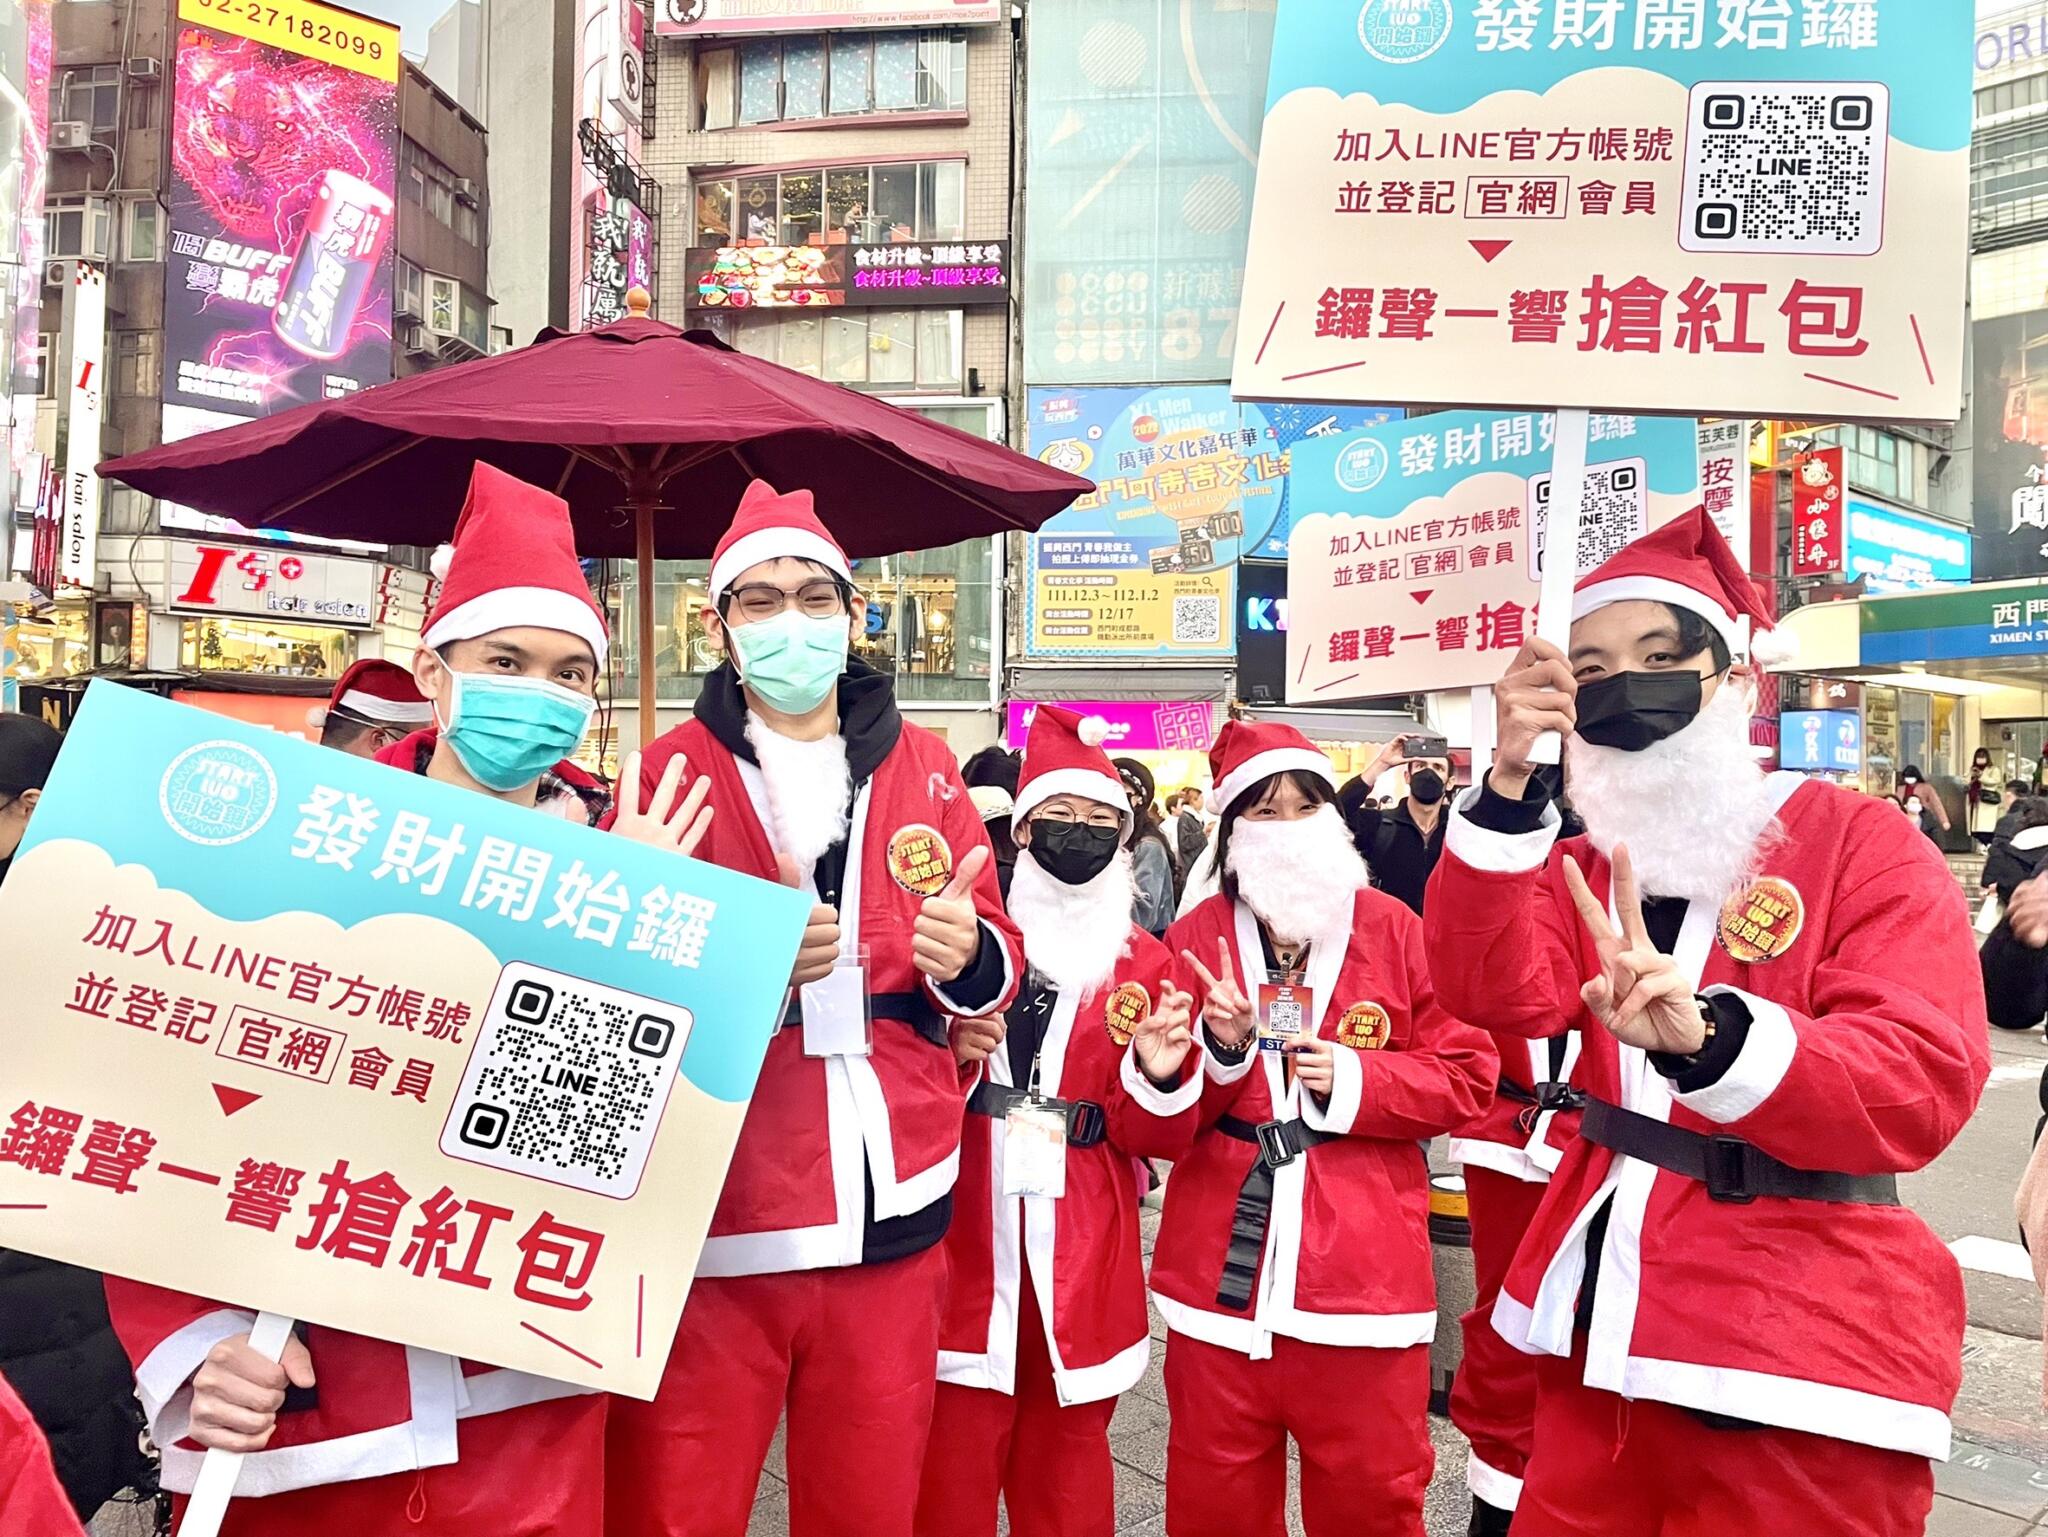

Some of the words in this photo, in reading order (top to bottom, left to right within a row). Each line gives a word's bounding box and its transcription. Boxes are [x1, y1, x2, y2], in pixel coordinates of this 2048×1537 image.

[1471, 0, 1879, 52] 發財開始鑼
[1333, 127, 1674, 162] 加入LINE官方帳號
[1755, 157, 1812, 176] LINE
[1334, 180, 1456, 215] 並登記
[1476, 180, 1557, 216] 官網
[1577, 179, 1657, 216] 會員
[1314, 275, 1869, 358] 鑼聲一響搶紅包
[1162, 409, 1228, 435] Walker
[1118, 428, 1257, 471] 萬華文化嘉年華
[74, 472, 88, 505] hair
[1702, 457, 1734, 513] 按摩
[72, 513, 85, 564] salon
[1329, 506, 1521, 556] 加入LINE官方帳號
[1579, 513, 1603, 527] INE
[1333, 557, 1400, 587] 並登記
[1411, 552, 1457, 576] 官網
[1468, 541, 1515, 569] 會員
[1099, 608, 1134, 619] 12/17
[1328, 600, 1540, 663] 鑼聲一響搶
[1992, 599, 2048, 628] 西門
[1990, 631, 2032, 644] XIMEN
[291, 784, 717, 969] 發財開始鑼
[82, 904, 471, 1044] 加入LINE官方帳號
[65, 971, 218, 1045] 並登記
[235, 1017, 333, 1076] 官網
[349, 1046, 435, 1103] 會員
[541, 1064, 599, 1097] LINE
[0, 1099, 605, 1311] 鑼聲一響搶紅包
